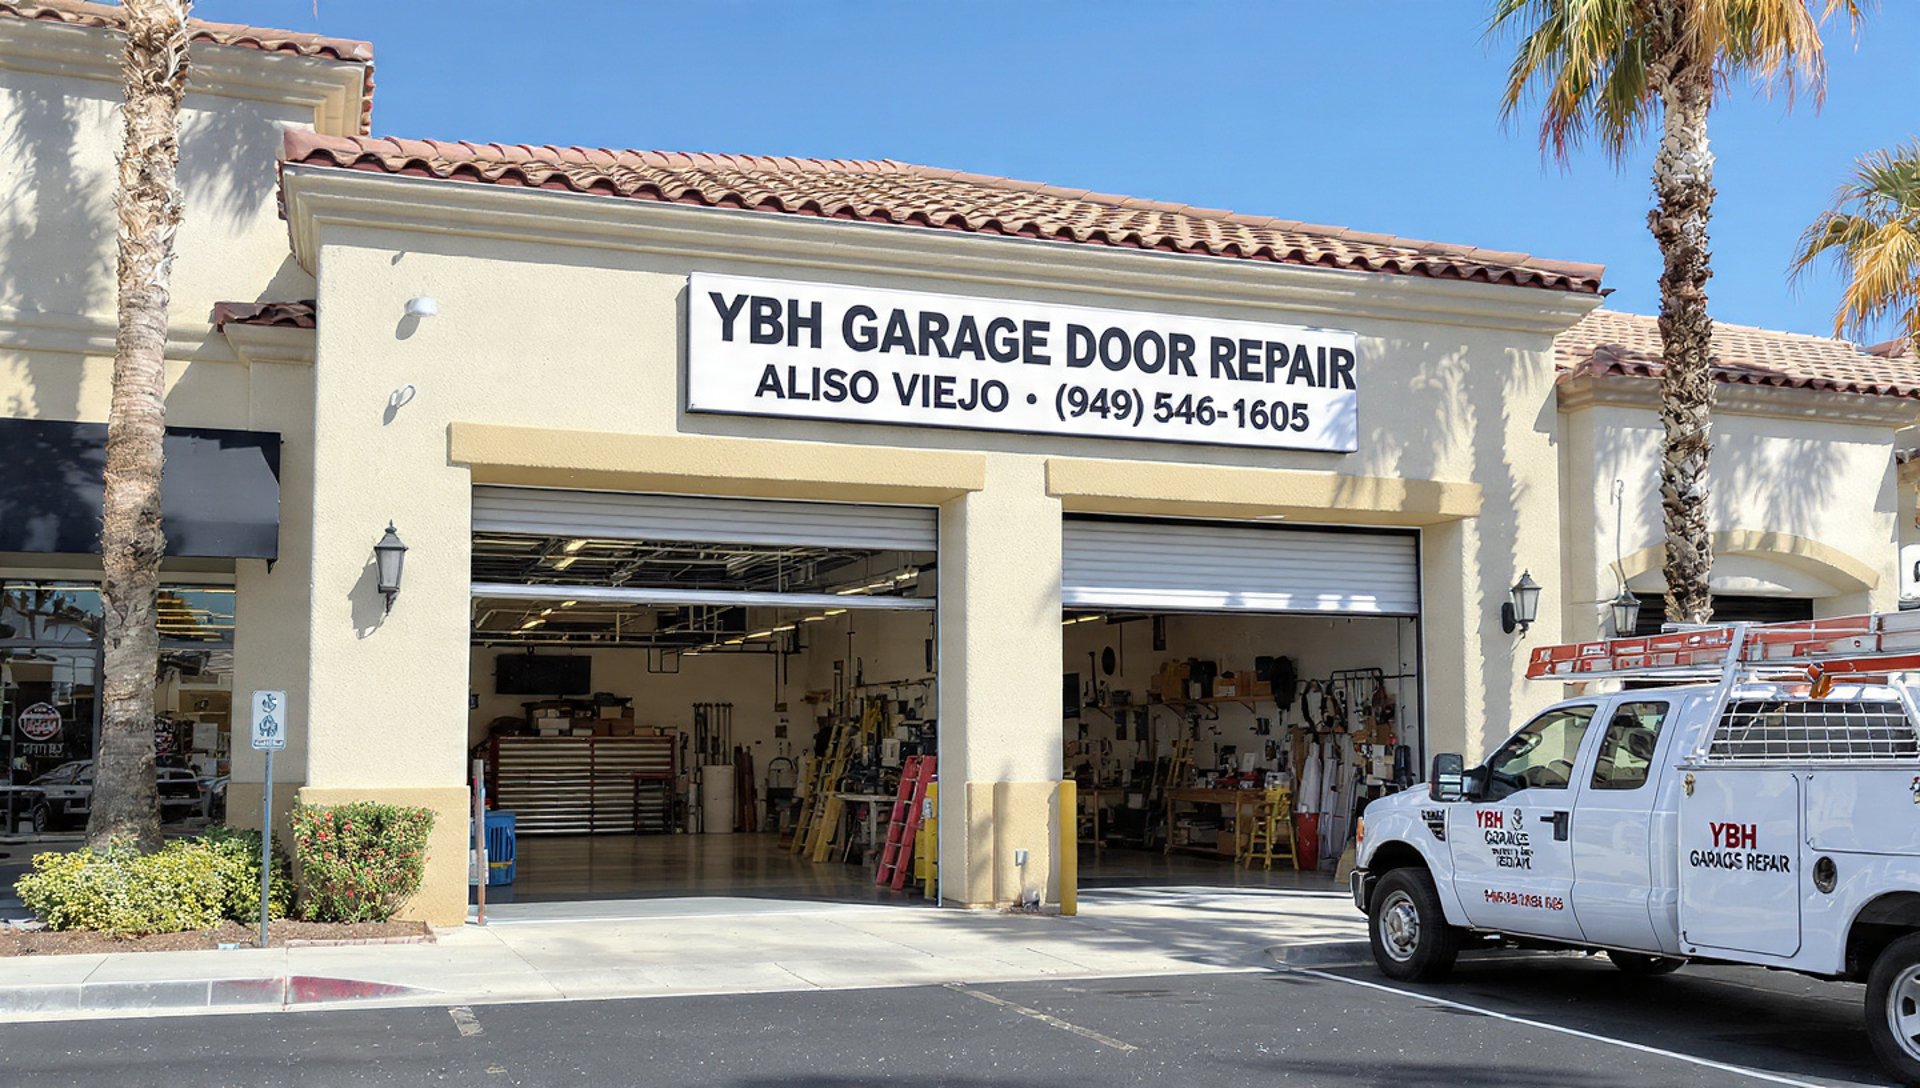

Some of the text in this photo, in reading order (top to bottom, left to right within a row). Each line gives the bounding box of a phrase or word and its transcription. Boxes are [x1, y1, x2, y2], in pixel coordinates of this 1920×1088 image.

[707, 291, 1357, 391] YBH GARAGE DOOR REPAIR
[754, 363, 879, 405] ALISO
[891, 371, 1009, 413] VIEJO
[1055, 383, 1144, 428] (949)
[1153, 391, 1310, 433] 546-1605
[1476, 810, 1504, 829] YBH
[1709, 822, 1757, 849] YBH
